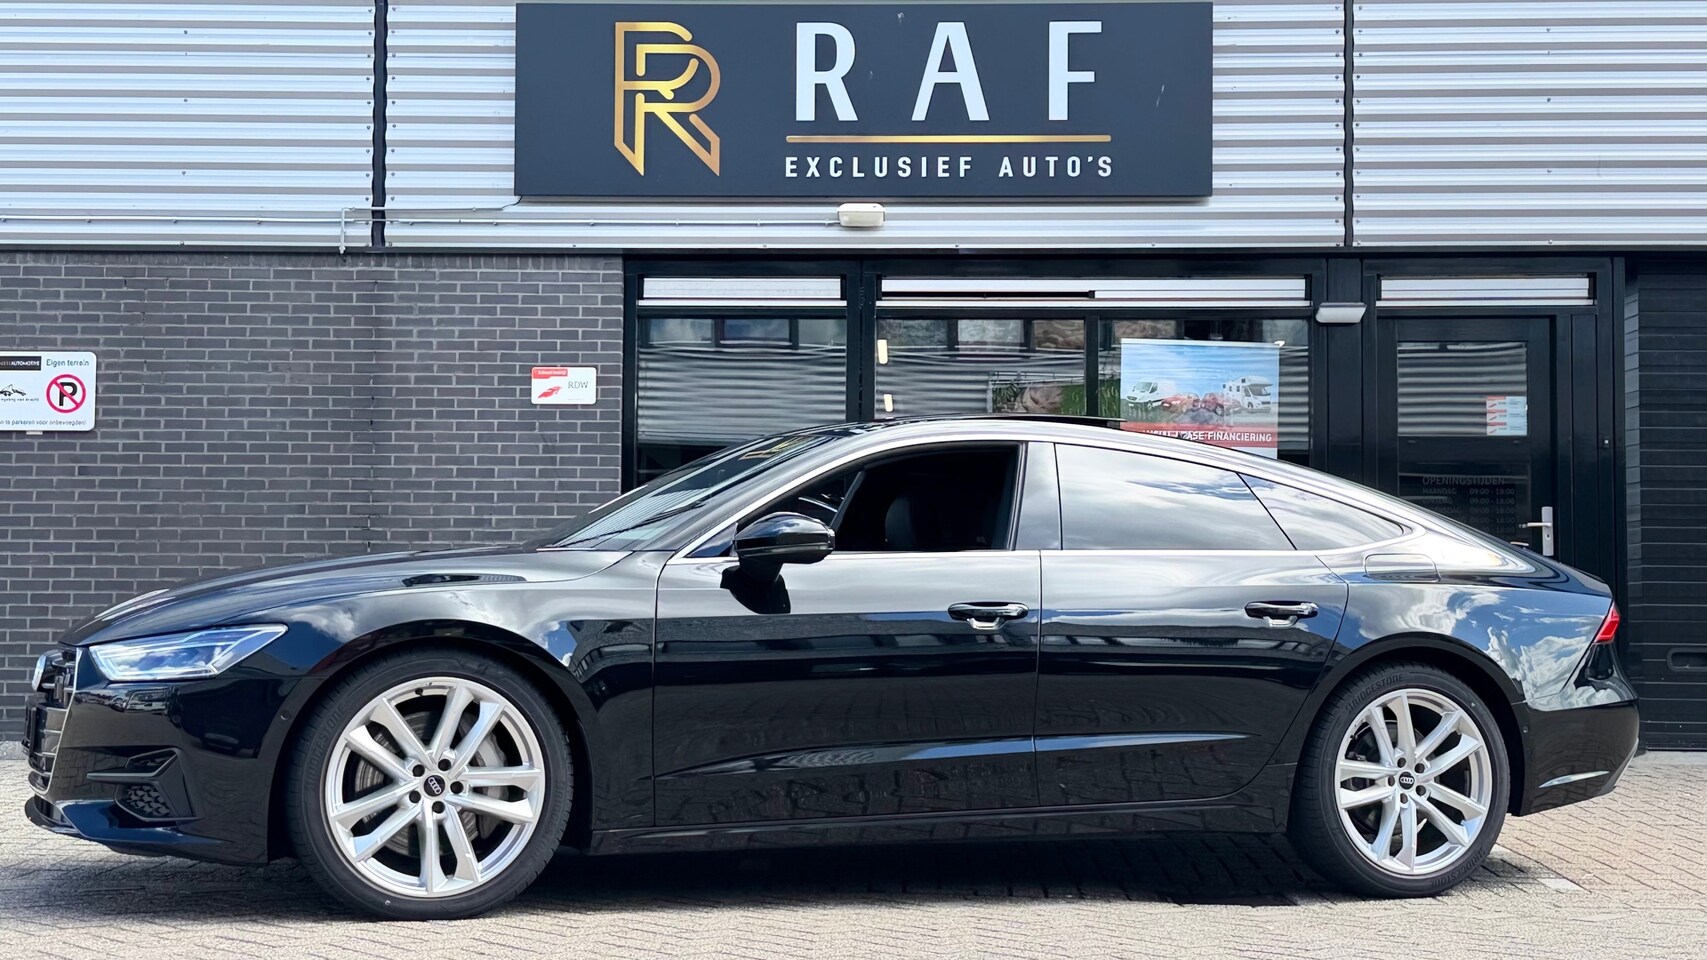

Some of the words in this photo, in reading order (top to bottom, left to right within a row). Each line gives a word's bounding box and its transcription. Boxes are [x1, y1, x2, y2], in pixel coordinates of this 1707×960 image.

[795, 21, 1103, 122] RAF
[785, 156, 972, 178] EXCLUSIEF
[998, 156, 1112, 178] AUTO'S
[46, 359, 66, 368] Eigen
[67, 359, 90, 367] terrein
[567, 381, 589, 389] RDW
[1207, 432, 1273, 442] FINANCIERING
[1422, 476, 1505, 486] OPENINGSTIJDEN
